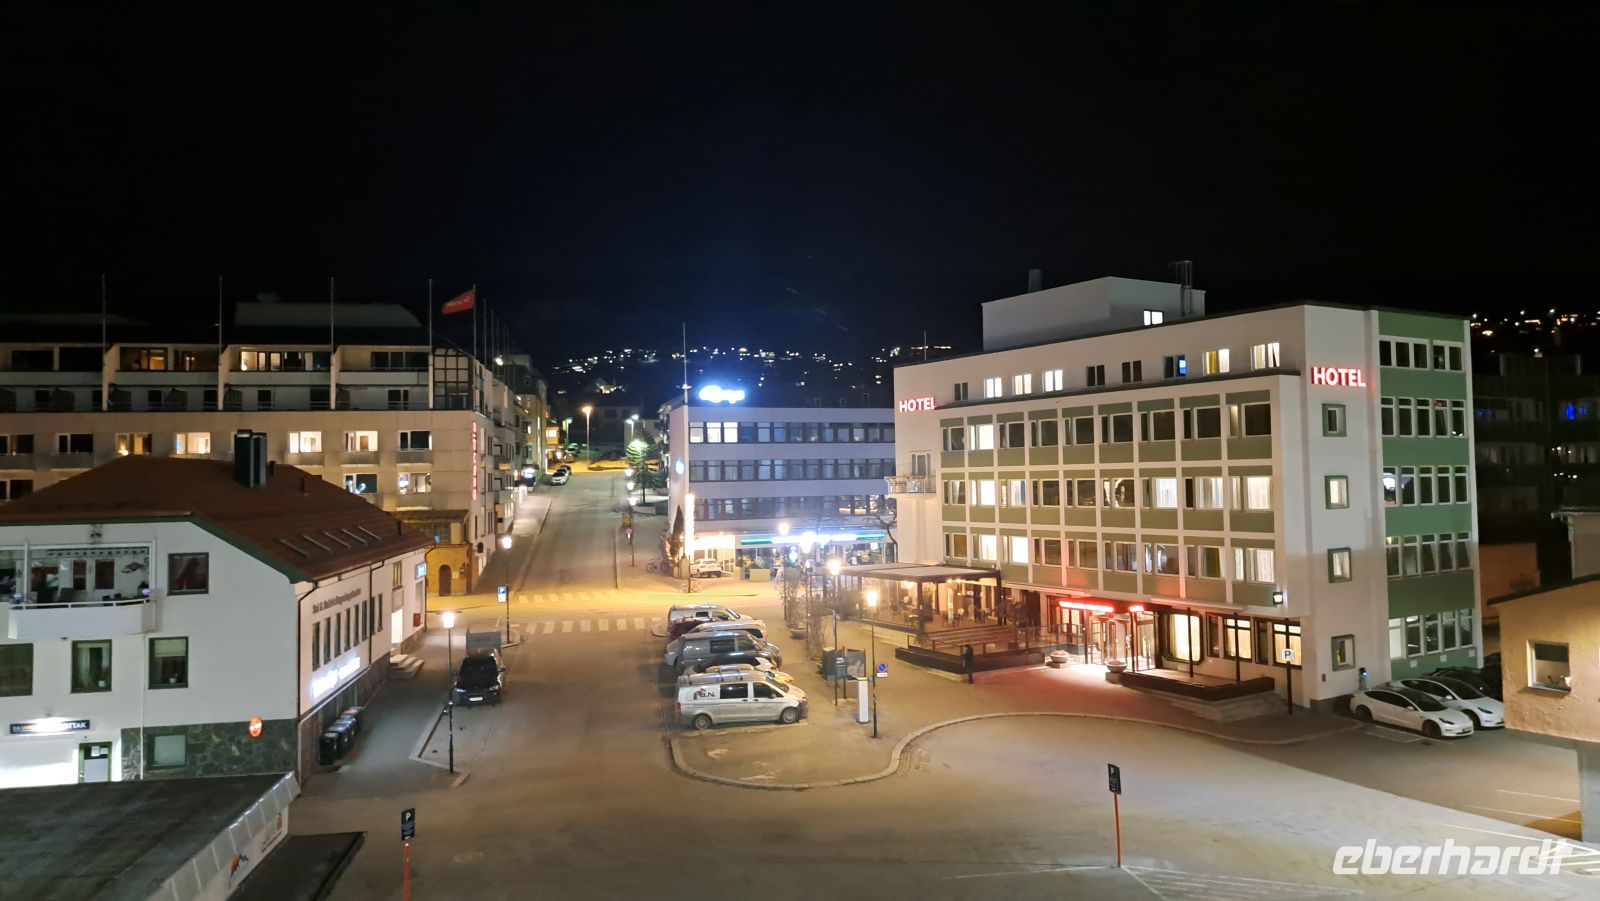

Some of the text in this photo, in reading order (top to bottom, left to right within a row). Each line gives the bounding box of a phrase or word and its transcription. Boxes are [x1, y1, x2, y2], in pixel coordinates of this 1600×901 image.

[1311, 366, 1366, 387] HOTEL
[899, 397, 935, 413] HOTEL
[1284, 650, 1292, 660] P
[405, 812, 411, 821] P
